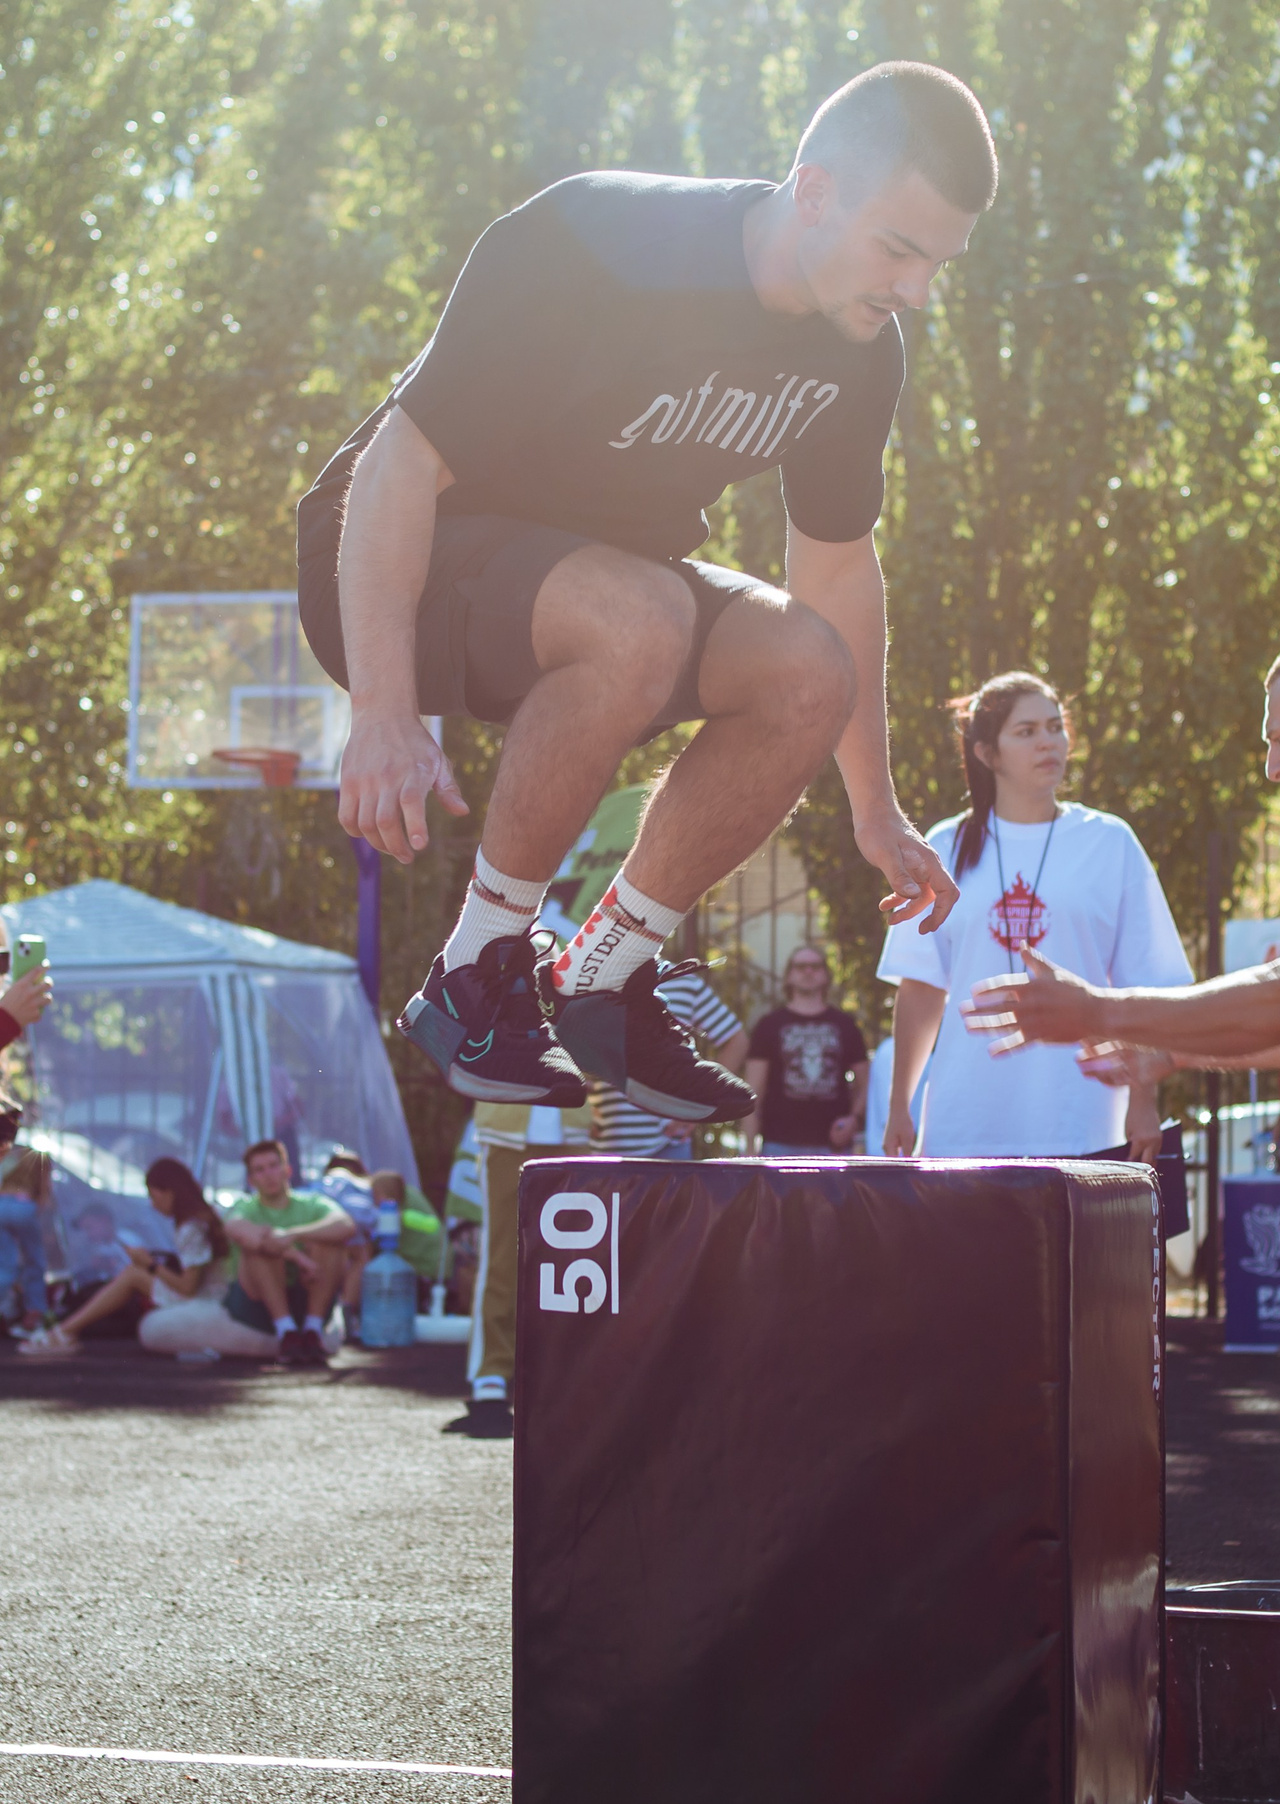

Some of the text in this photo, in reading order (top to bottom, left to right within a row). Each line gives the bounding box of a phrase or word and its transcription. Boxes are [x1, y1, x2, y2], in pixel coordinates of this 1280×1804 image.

[575, 918, 631, 995] JUST DO IT
[540, 1192, 607, 1314] 50
